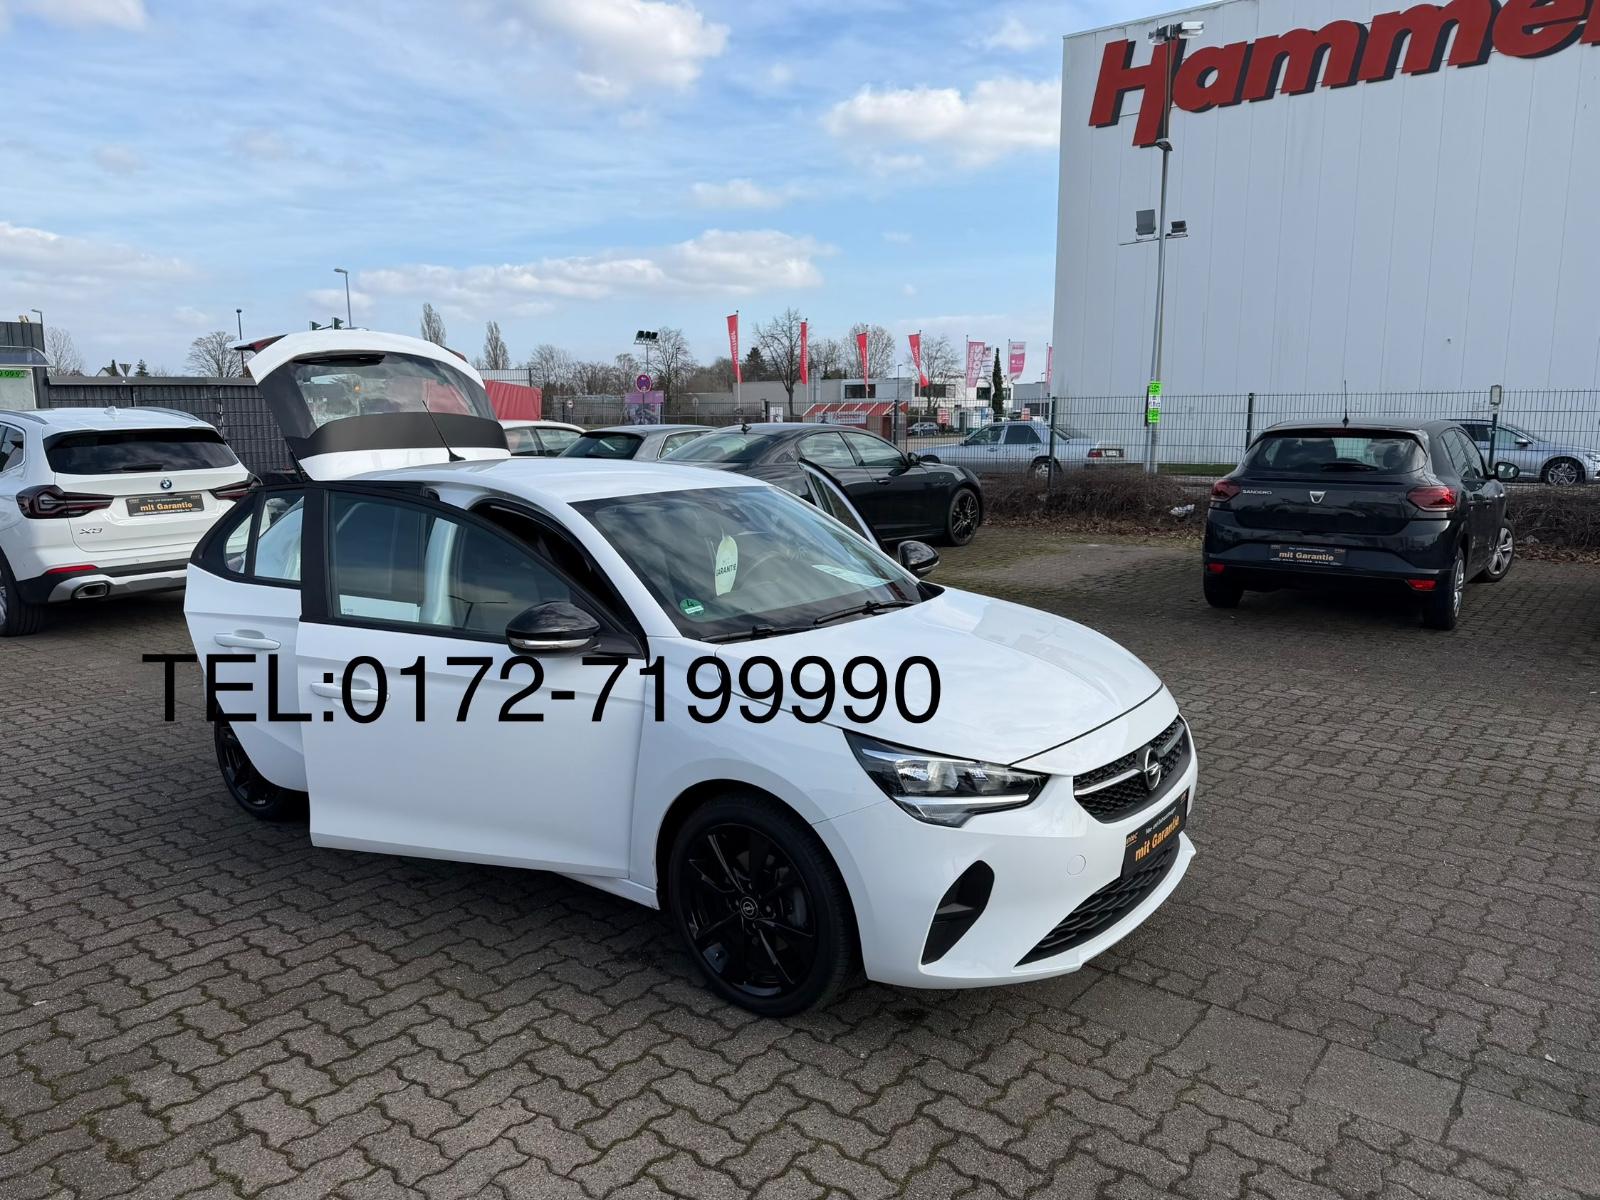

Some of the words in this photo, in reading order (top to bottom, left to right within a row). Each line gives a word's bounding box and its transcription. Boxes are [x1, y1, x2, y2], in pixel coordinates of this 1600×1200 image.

[140, 503, 155, 512] mit
[156, 501, 193, 510] Garantie
[1295, 552, 1334, 561] Garantie
[1135, 839, 1150, 862] mit
[1151, 815, 1180, 849] Garantie
